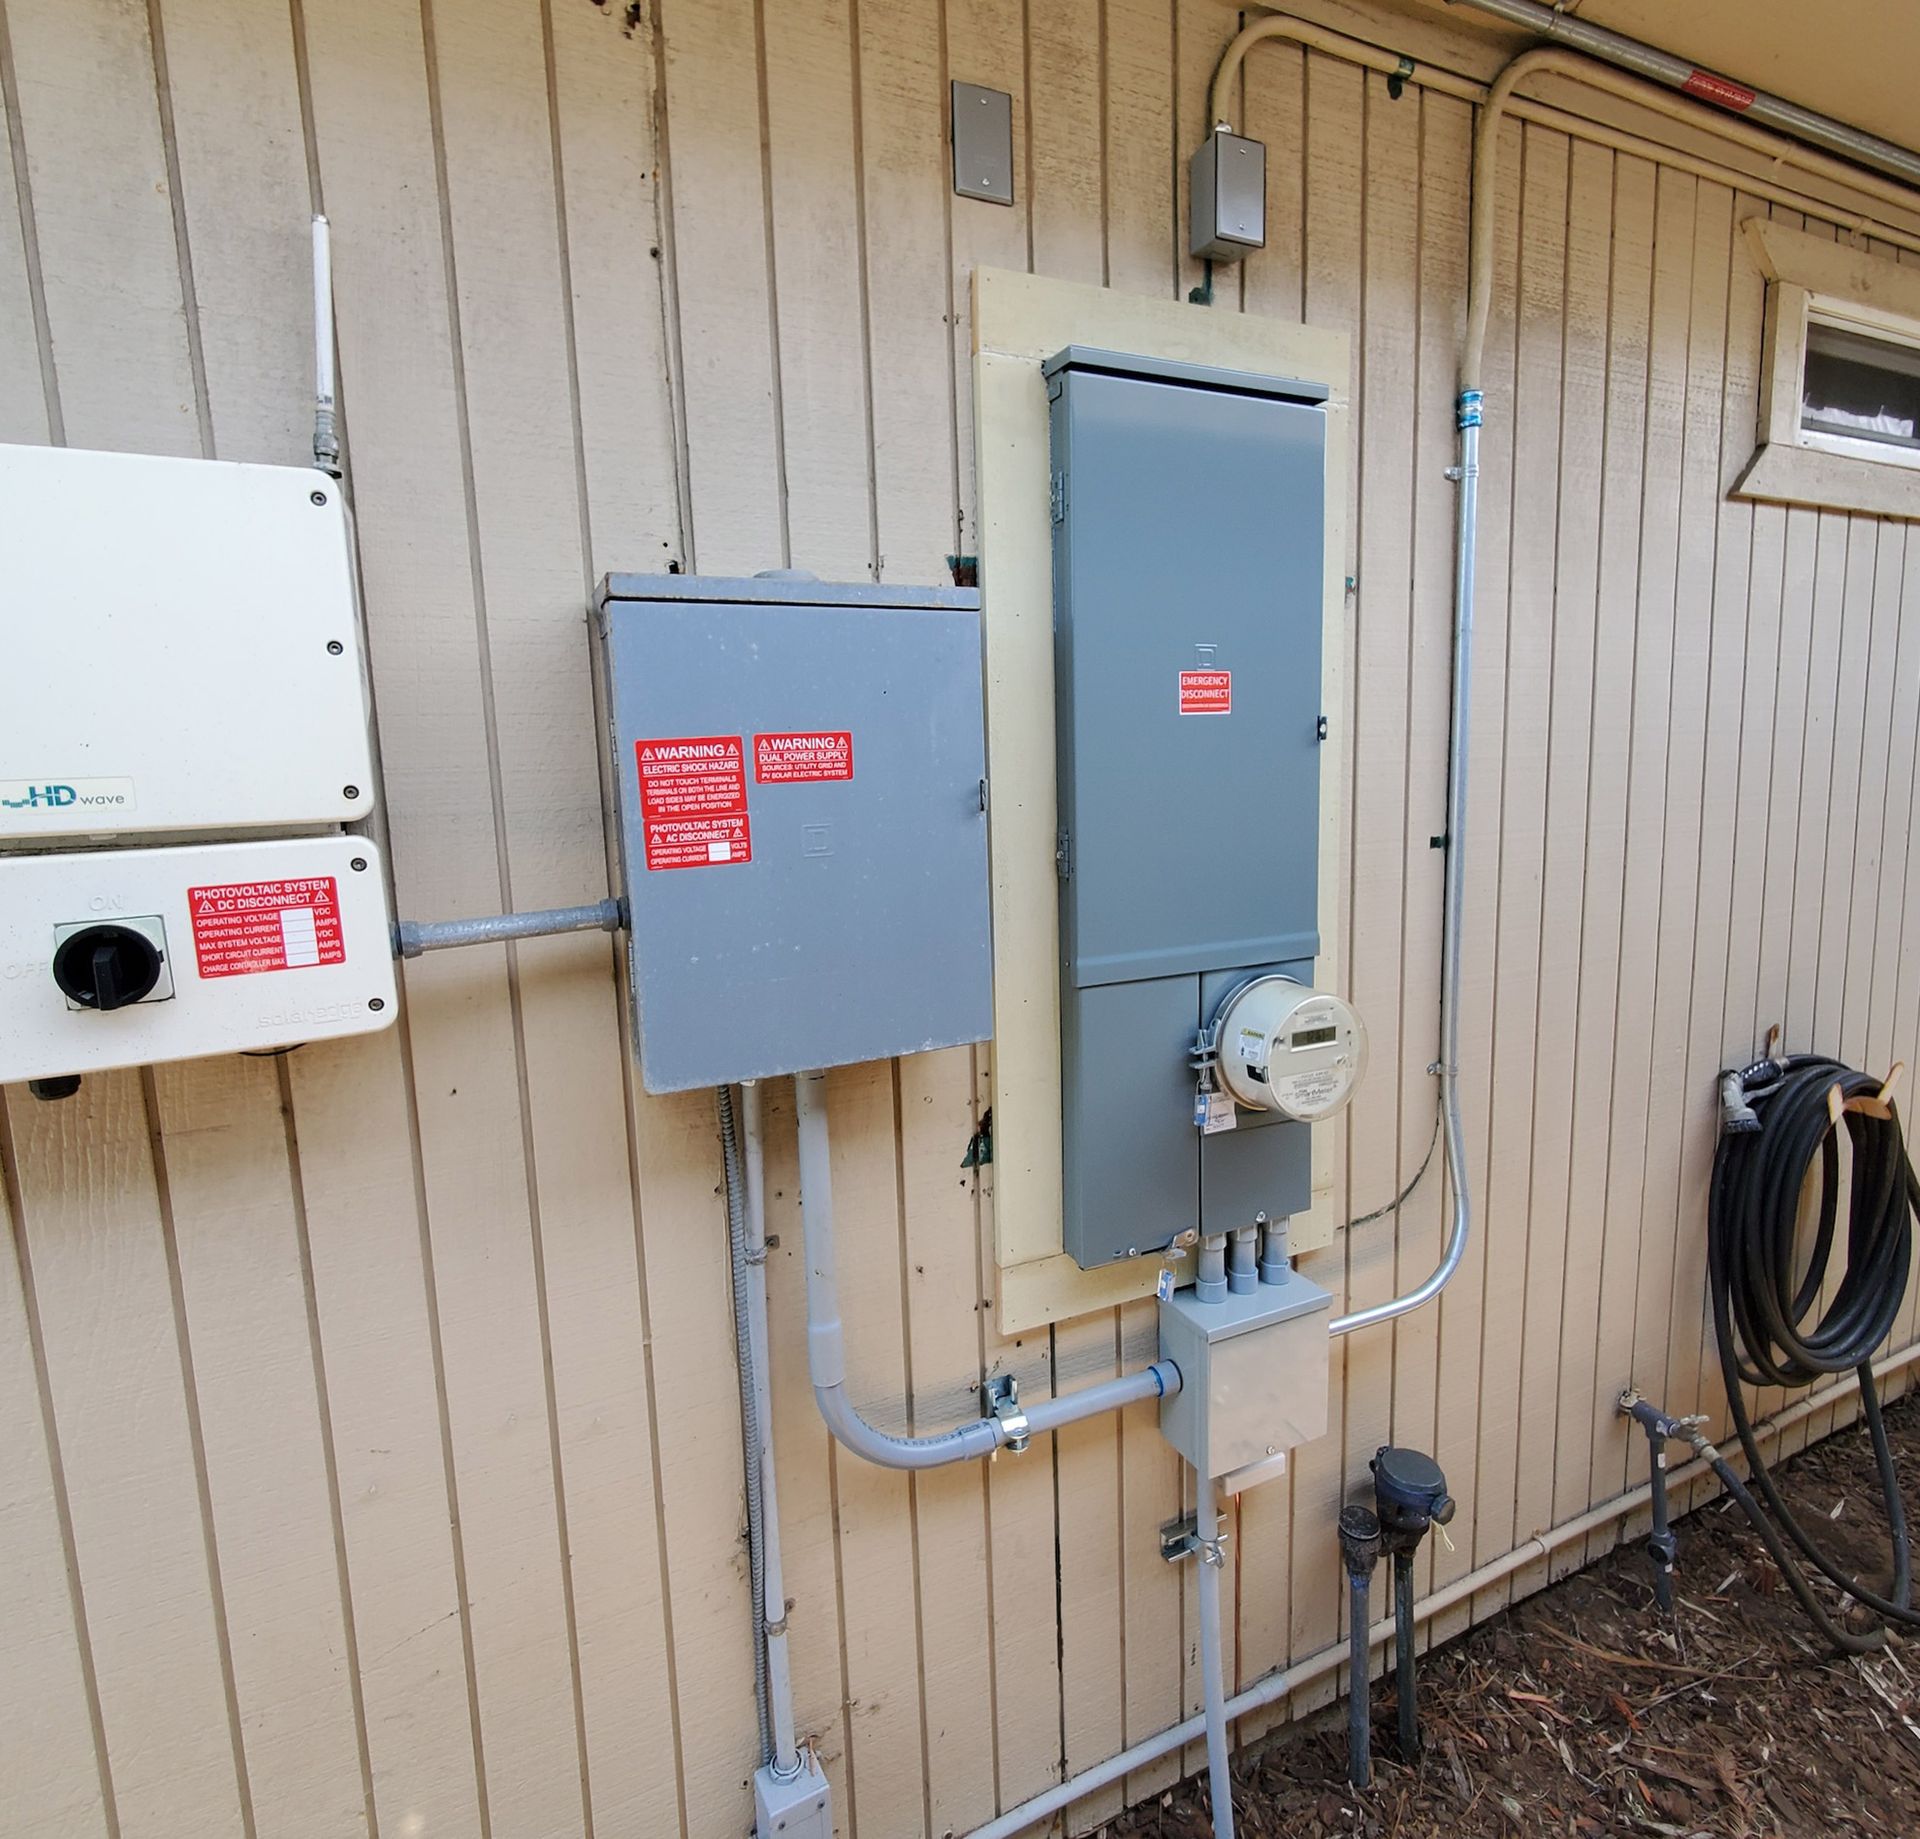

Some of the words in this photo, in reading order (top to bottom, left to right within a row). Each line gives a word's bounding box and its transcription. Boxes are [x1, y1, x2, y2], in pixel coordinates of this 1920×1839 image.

[1182, 677, 1228, 685] EMERGENCY
[1182, 689, 1228, 698] DISCONNECT
[771, 737, 834, 750] WARNING
[655, 744, 725, 759] WARNING
[760, 753, 782, 762] DUAL
[784, 753, 814, 761] POWER
[816, 752, 848, 760] SUPPLY
[643, 764, 680, 775] ELECTRIC
[681, 762, 708, 772] SHOCK
[709, 760, 738, 770] HAZARD
[660, 779, 674, 787] NOT
[676, 778, 699, 786] TOUCH
[701, 775, 737, 785] TERMINALS
[29, 784, 76, 807] HD
[80, 795, 124, 804] wave
[646, 787, 677, 796] TERMINALS
[728, 782, 740, 790] AND
[648, 797, 664, 805] LOAD
[665, 796, 682, 804] SIDES
[681, 803, 699, 811] OPEN
[700, 801, 731, 809] POSITION
[650, 821, 710, 833] PHOTOVOLTAIC
[711, 818, 743, 828] SYSTEM
[665, 833, 680, 842] AC
[681, 831, 730, 841] DISCONNECT
[652, 847, 682, 856] OPERATING
[684, 845, 706, 853] VOLTAGE
[651, 855, 682, 865] OPERATING
[682, 854, 707, 862] CURRENT
[194, 884, 282, 900] PHOTOVOLTAIC
[284, 880, 329, 892] SYSTEM
[218, 900, 235, 911] DC
[237, 893, 310, 909] DISCONNECT
[196, 916, 242, 927] OPERATING
[244, 913, 279, 923] VOLTAGE
[198, 927, 242, 938] OPERATING
[244, 924, 280, 934] CURRENT
[316, 918, 337, 926] AMPS
[199, 942, 216, 950] MAX
[217, 938, 247, 948] SYSTEM
[249, 935, 281, 944] VOLTAGE
[201, 953, 224, 962] SHORT
[226, 950, 251, 959] CIRCUIT
[253, 946, 283, 956] CURRENT
[203, 964, 228, 973] CHARGE
[230, 960, 270, 970] CONTROLLER
[320, 951, 342, 959] AMPS
